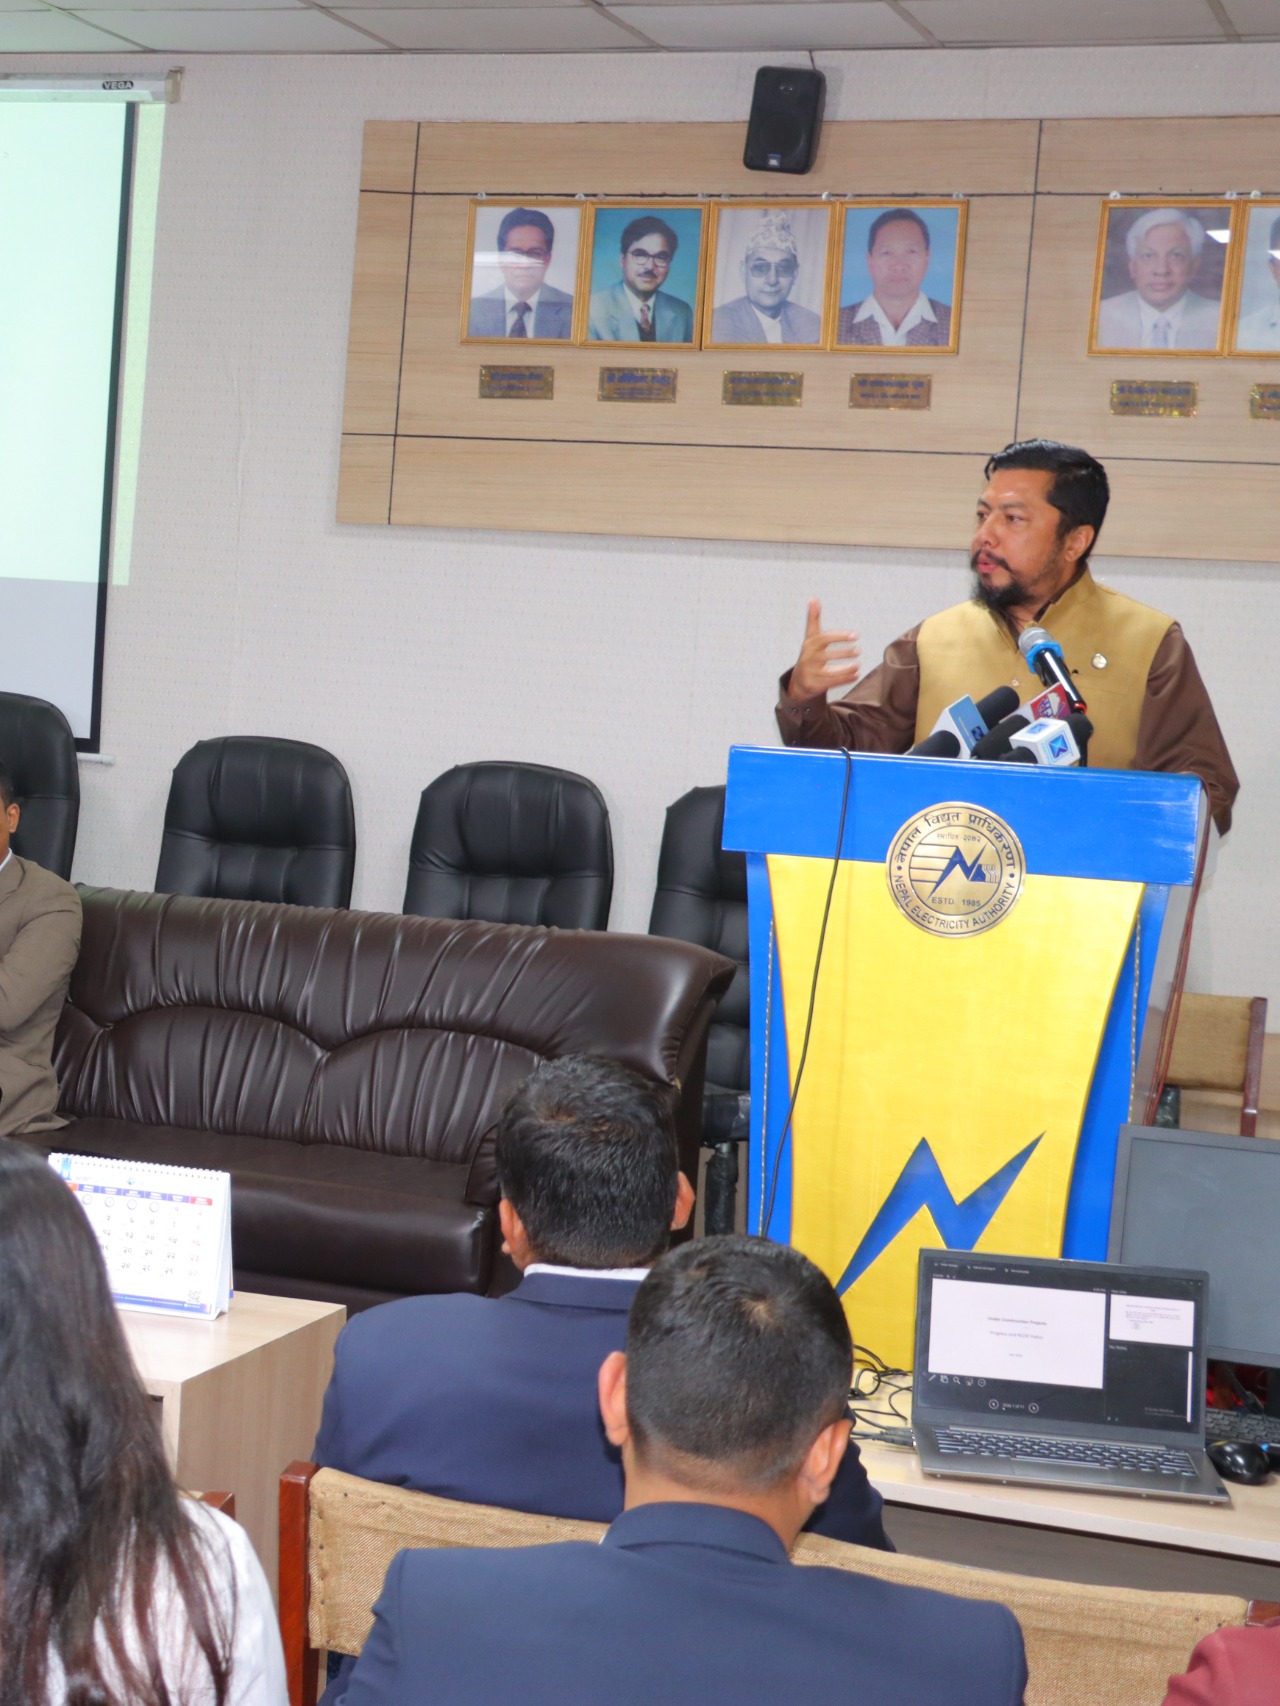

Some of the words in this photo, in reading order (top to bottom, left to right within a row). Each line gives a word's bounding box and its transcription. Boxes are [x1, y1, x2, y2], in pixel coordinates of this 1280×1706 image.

[104, 80, 133, 90] VEGA
[894, 826, 922, 863] नेपाल
[893, 875, 913, 908] NEPAL
[910, 905, 970, 930] ELECTRICITY
[972, 882, 1016, 927] AUTHORITY
[962, 898, 981, 907] 1985
